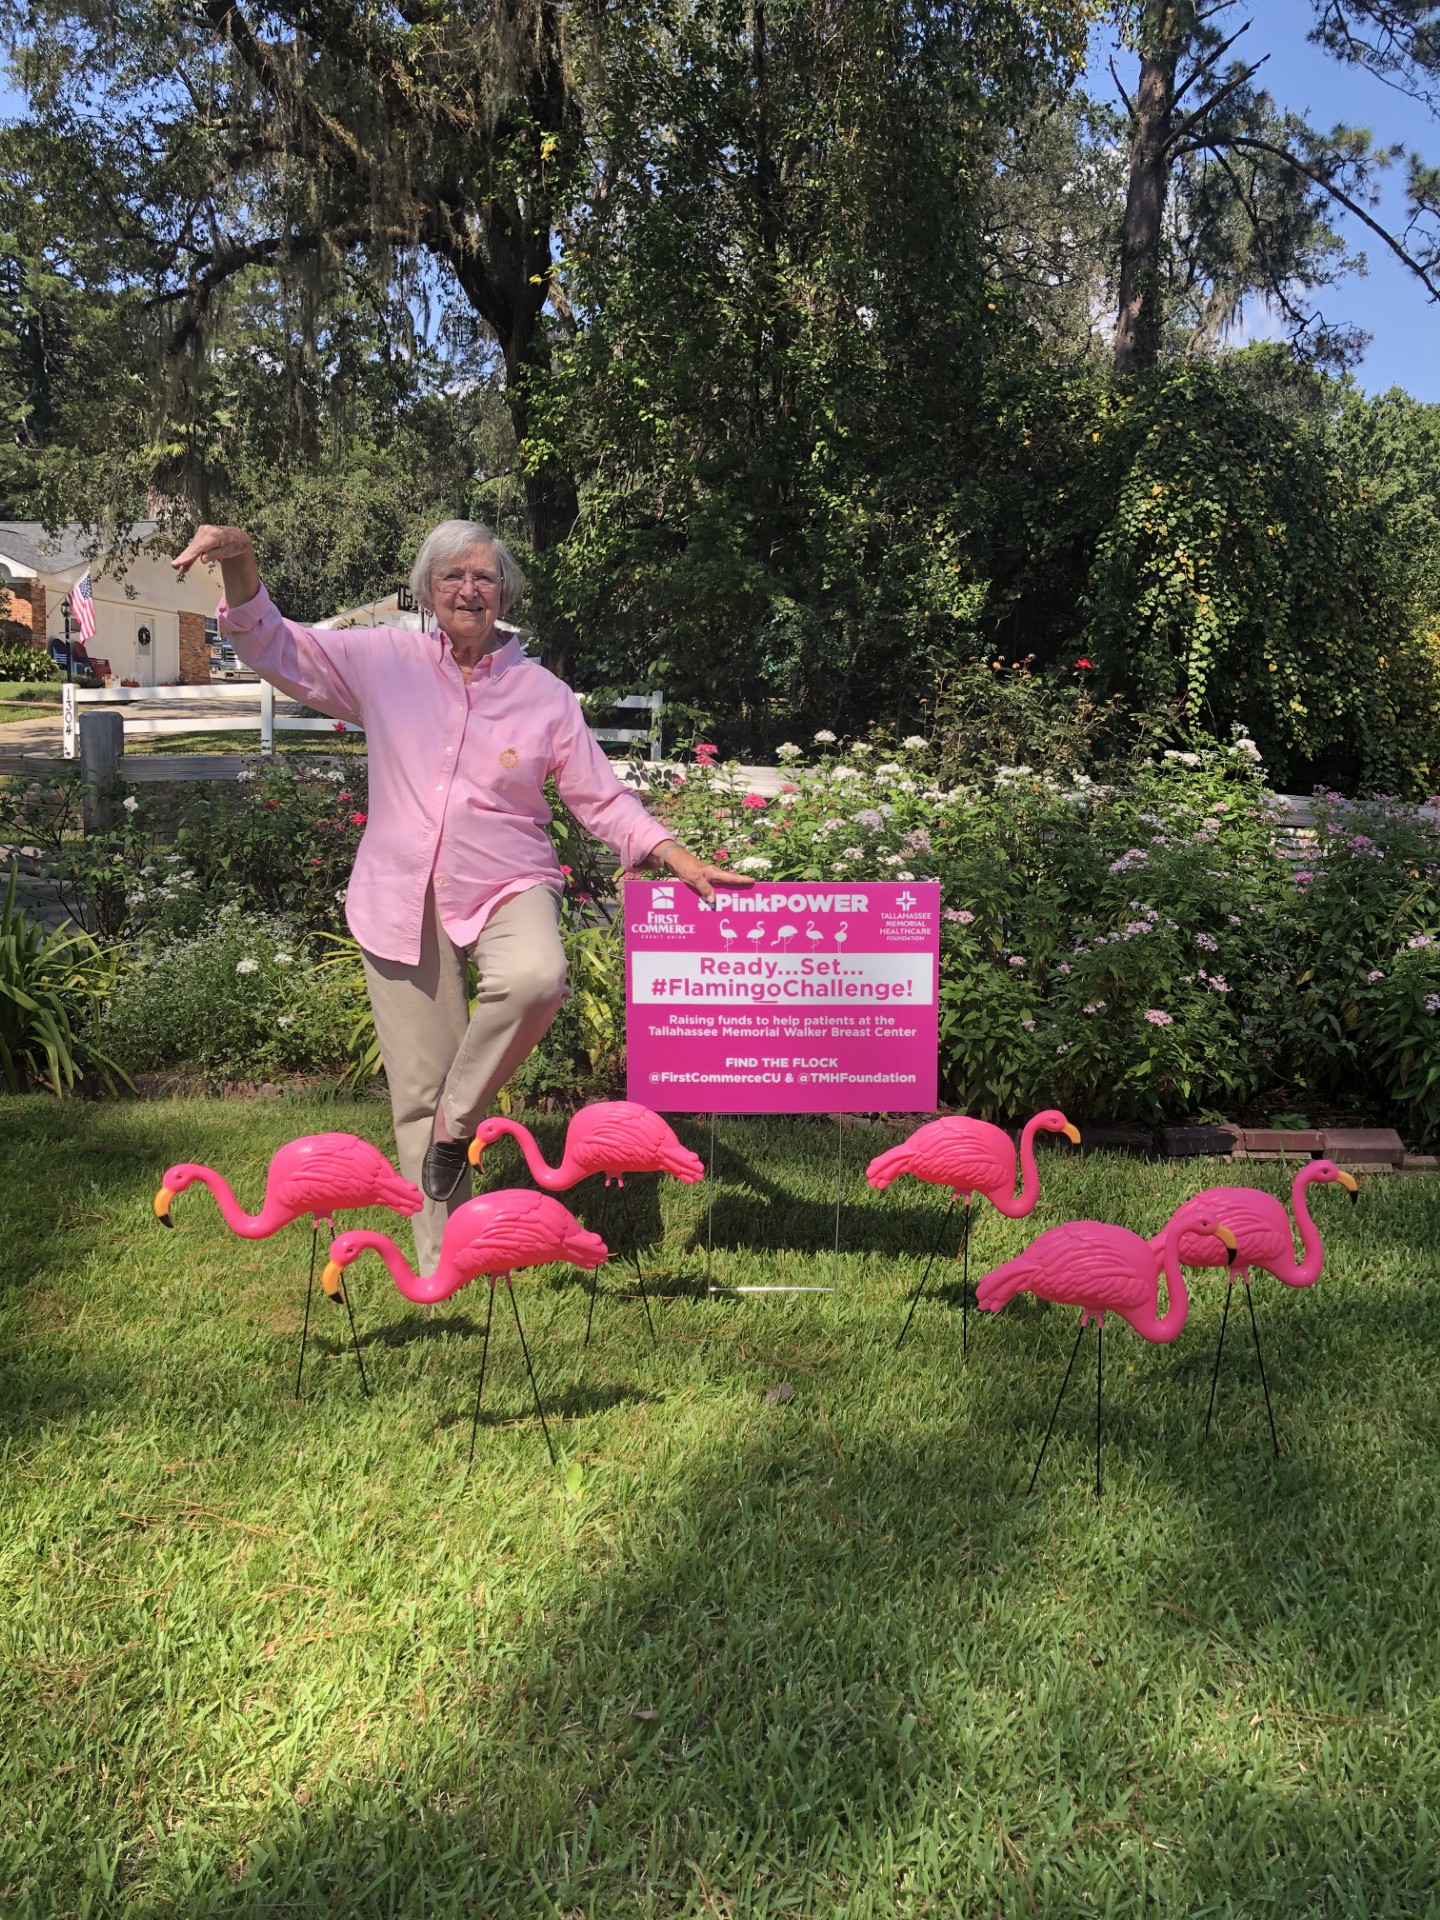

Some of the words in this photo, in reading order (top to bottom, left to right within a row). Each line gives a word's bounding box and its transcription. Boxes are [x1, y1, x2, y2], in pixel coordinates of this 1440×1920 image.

[64, 688, 72, 736] 1304
[648, 912, 679, 924] FIRST
[632, 923, 695, 934] COMMERCE
[652, 978, 912, 1000] #FlamingoChallenge!
[669, 1015, 714, 1027] Raising
[718, 1015, 752, 1026] funds
[756, 1016, 769, 1026] to
[773, 1015, 800, 1027] help
[804, 1015, 854, 1027] patients
[859, 1016, 871, 1026] at
[875, 1015, 895, 1026] the
[648, 1026, 719, 1037] Tallahassee
[723, 1026, 780, 1037] Memorial
[784, 1026, 827, 1037] Walker
[831, 1026, 871, 1037] Breast
[875, 1026, 916, 1037] Center
[725, 1058, 758, 1068] FIND
[762, 1058, 789, 1068] THE
[793, 1058, 838, 1068] FLOCK
[650, 1073, 780, 1084] @FirstCommerceCU
[785, 1073, 794, 1083] &
[798, 1073, 916, 1084] @TMHFoundation
